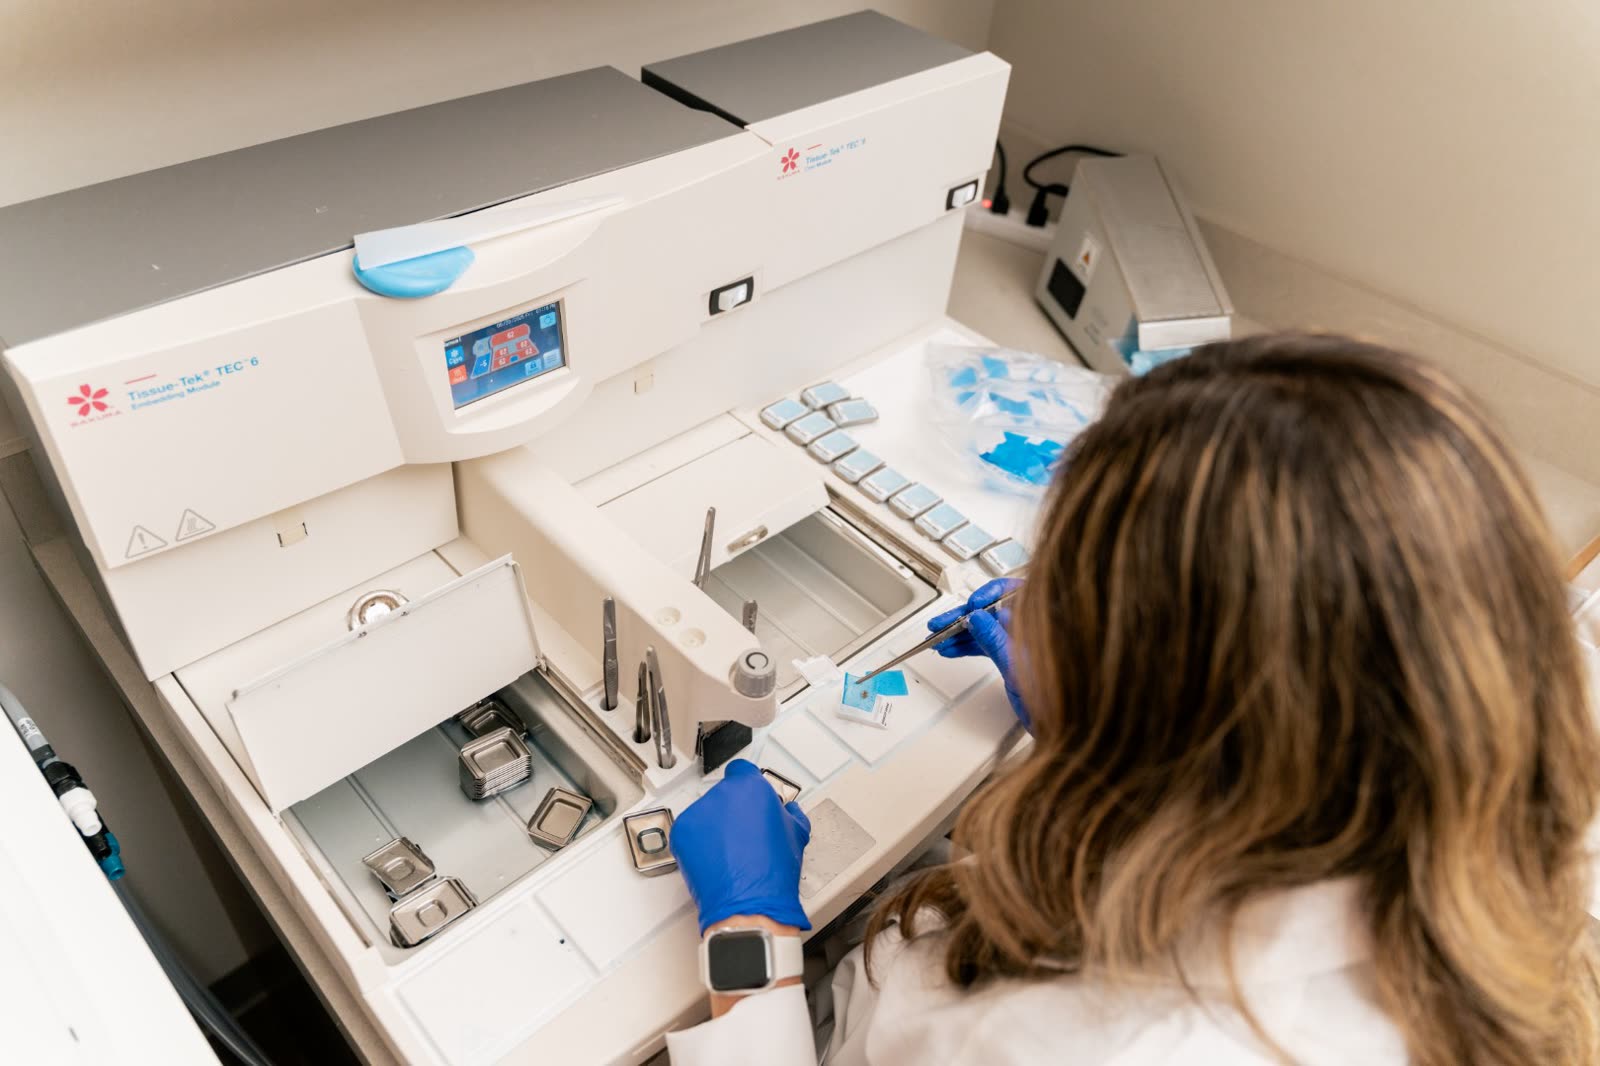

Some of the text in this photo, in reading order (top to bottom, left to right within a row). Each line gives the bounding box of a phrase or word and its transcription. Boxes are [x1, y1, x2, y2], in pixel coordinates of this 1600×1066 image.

[250, 356, 259, 367] 6
[131, 380, 221, 410] Embedding Module
